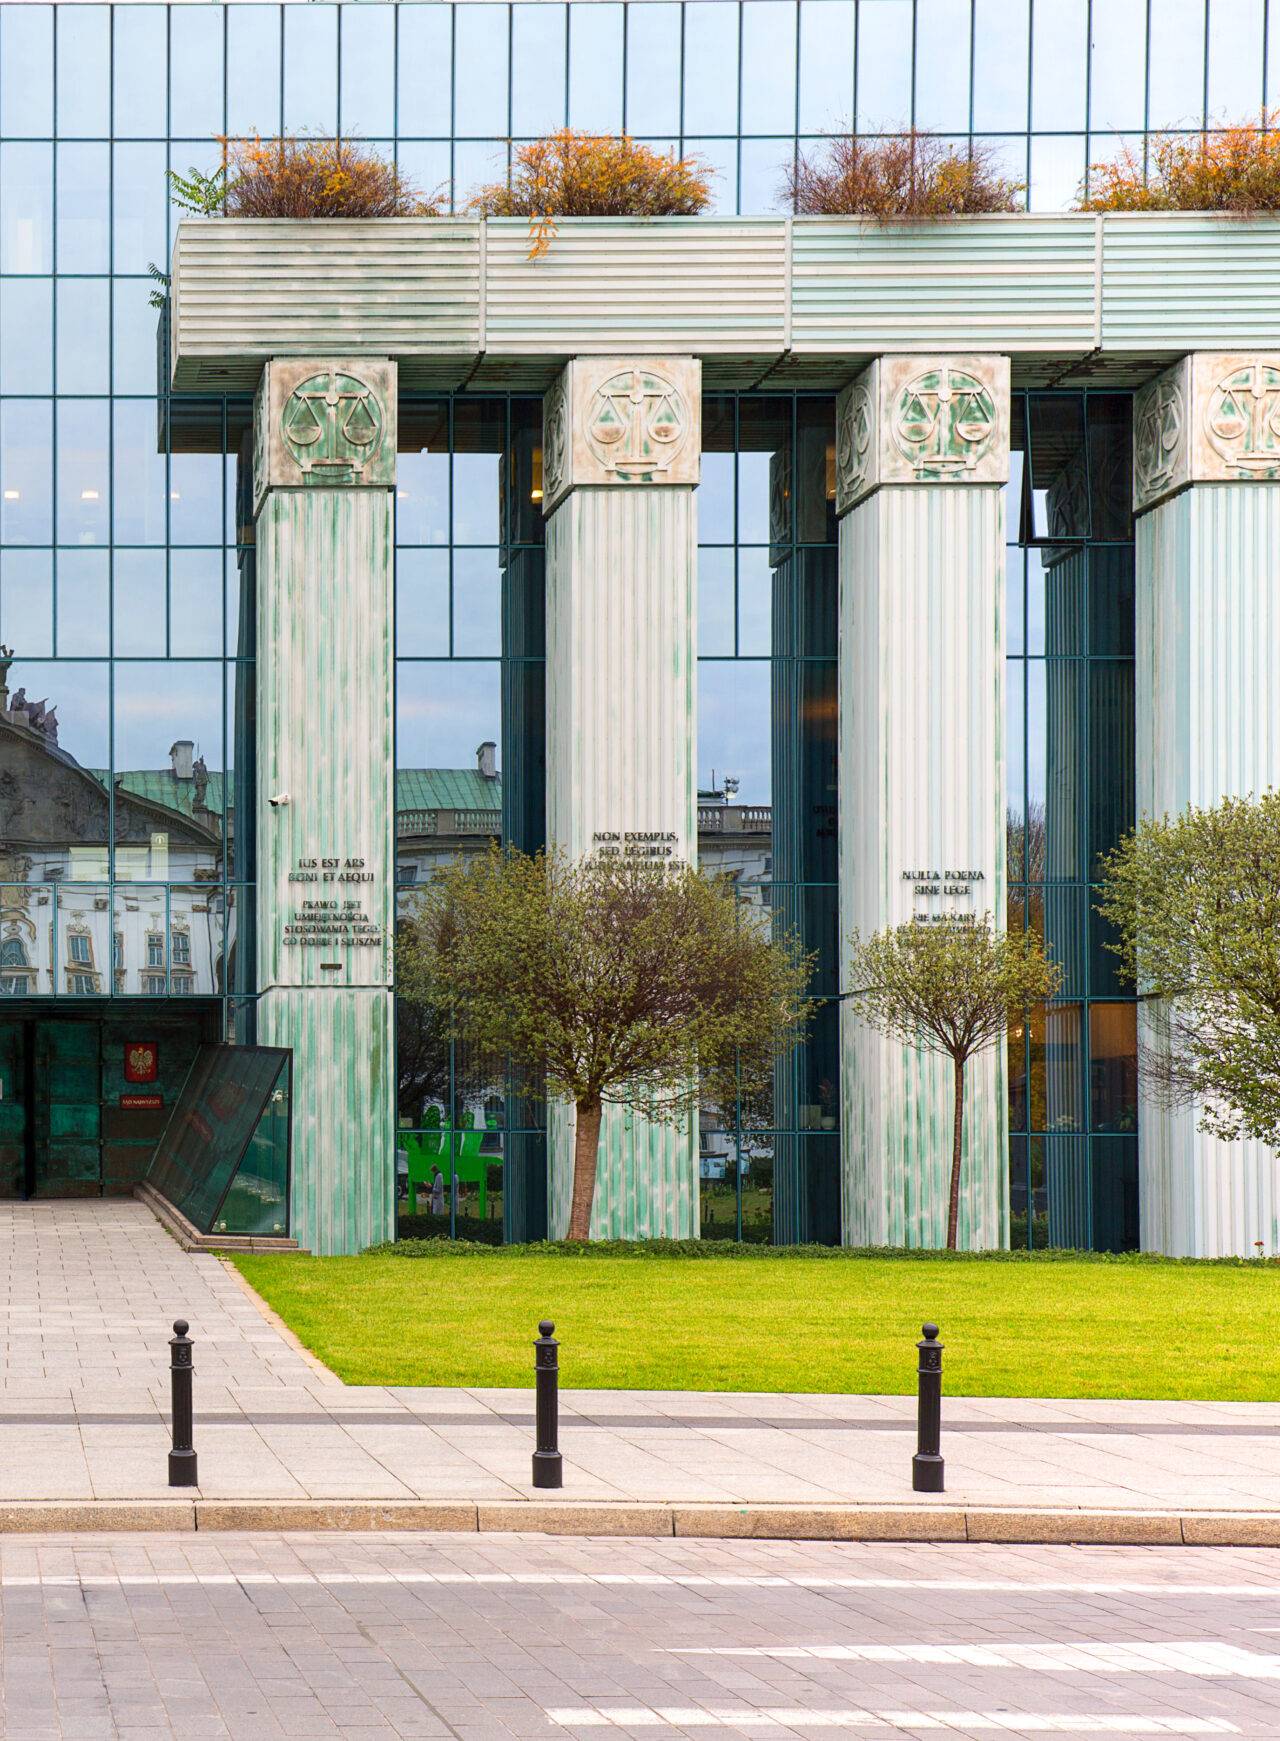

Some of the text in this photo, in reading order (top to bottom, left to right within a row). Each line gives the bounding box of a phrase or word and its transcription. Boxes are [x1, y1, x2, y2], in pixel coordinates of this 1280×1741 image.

[593, 832, 620, 841] NON
[599, 847, 672, 856] SED LEGIBUS
[299, 859, 365, 868] IUS EST ARS
[323, 873, 335, 881] ET
[338, 873, 374, 883] AEQUI
[902, 871, 985, 880] NULLA POENA
[914, 886, 971, 894] SINE LEGE
[913, 914, 930, 922] NIE
[284, 925, 349, 933] STOSOWANIA
